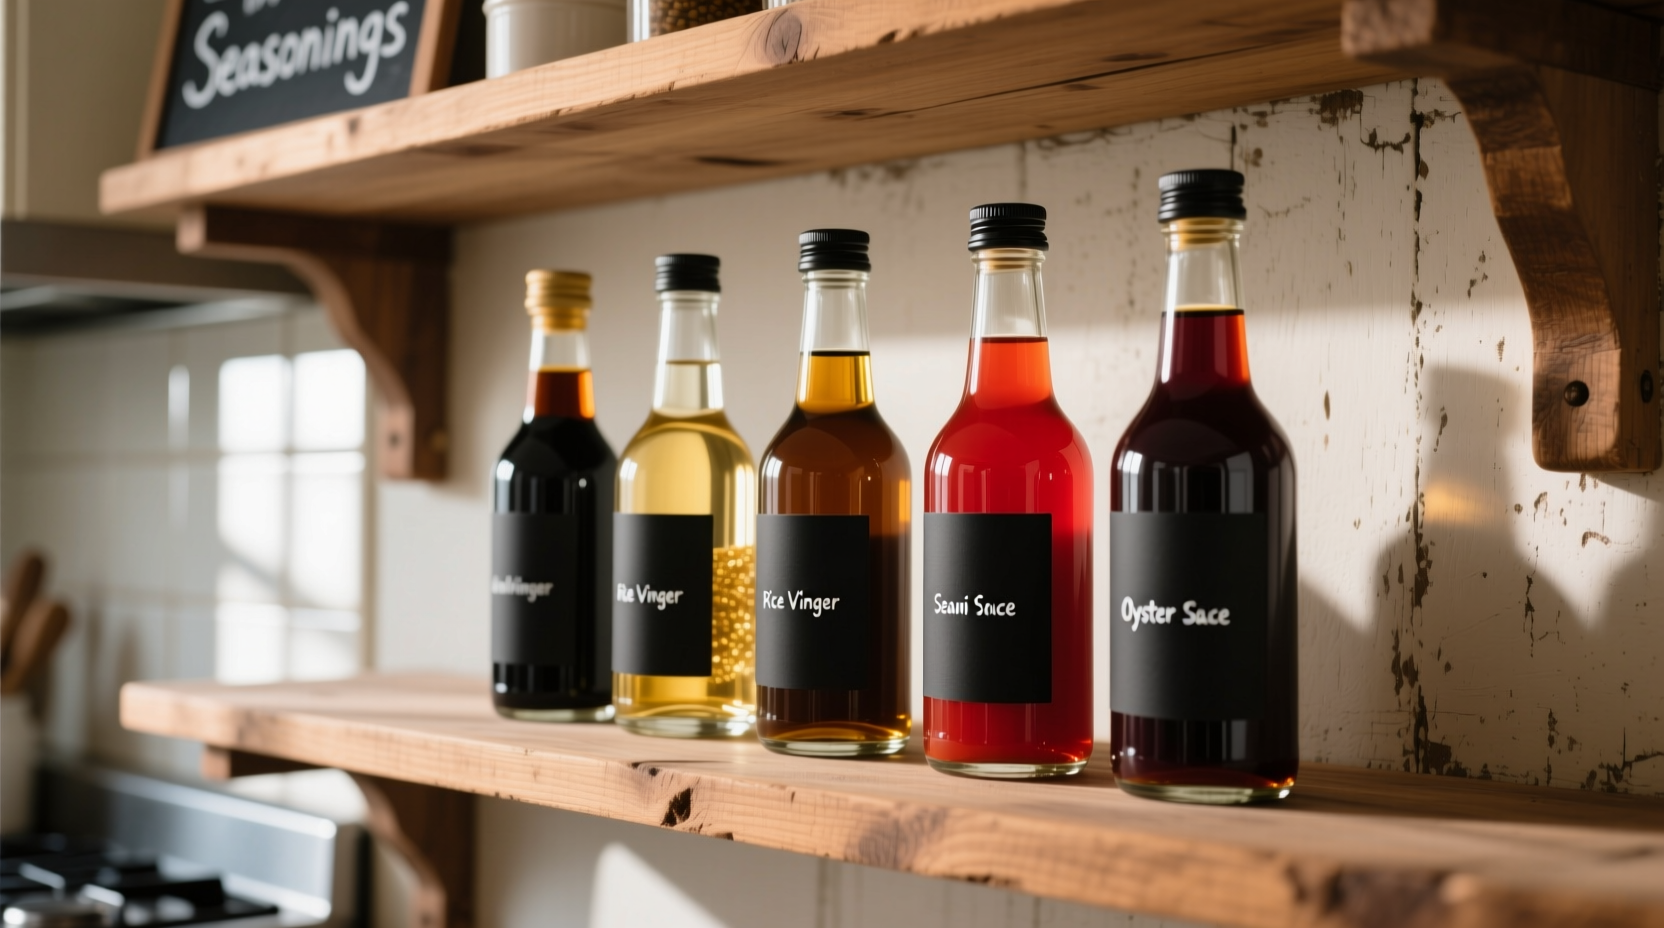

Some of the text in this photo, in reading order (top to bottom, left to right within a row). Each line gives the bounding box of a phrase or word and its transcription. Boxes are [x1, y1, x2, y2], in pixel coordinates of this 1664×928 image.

[182, 1, 409, 109] Seasonings
[787, 590, 840, 617] Vinger
[1121, 596, 1231, 632] Oyster Sace
